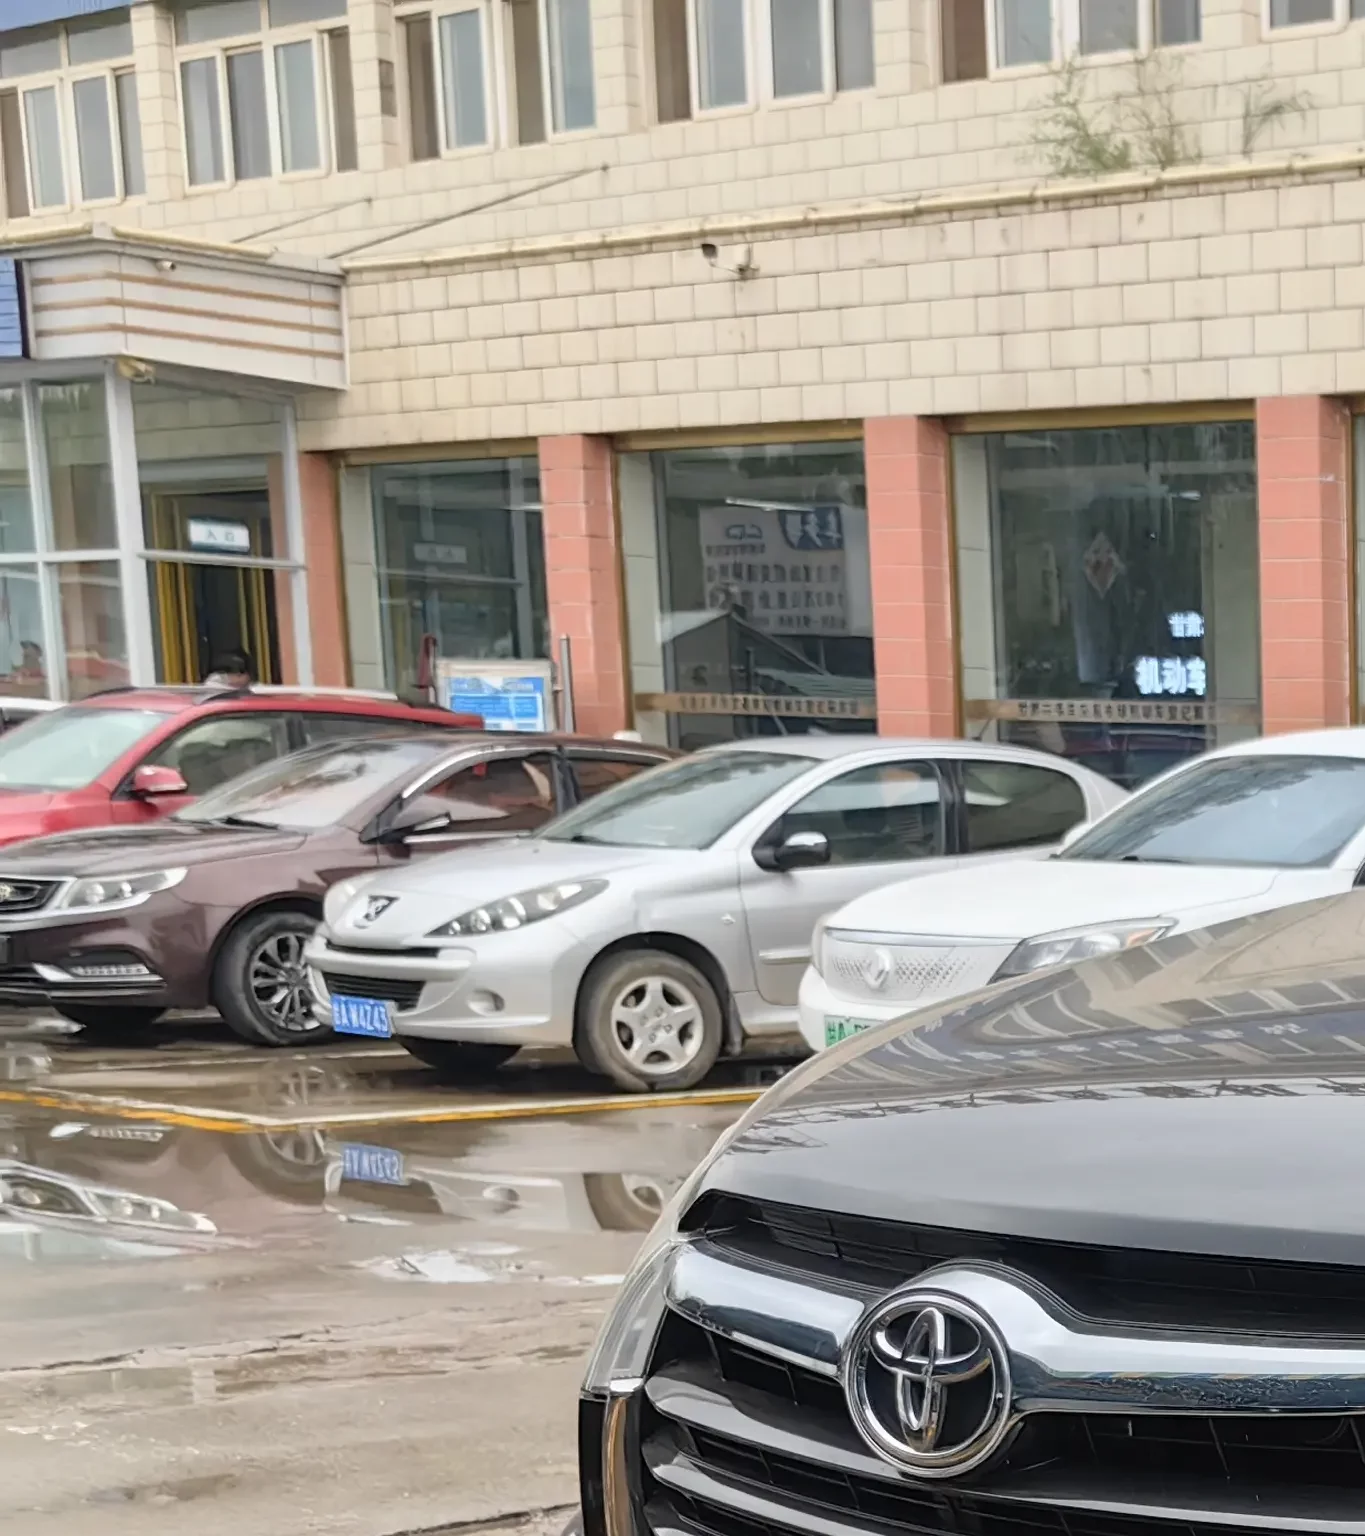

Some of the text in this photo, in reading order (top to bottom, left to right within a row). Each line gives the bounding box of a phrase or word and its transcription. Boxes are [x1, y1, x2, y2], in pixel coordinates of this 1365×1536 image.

[1167, 611, 1205, 637] 甘肃
[1135, 656, 1206, 696] 机动车
